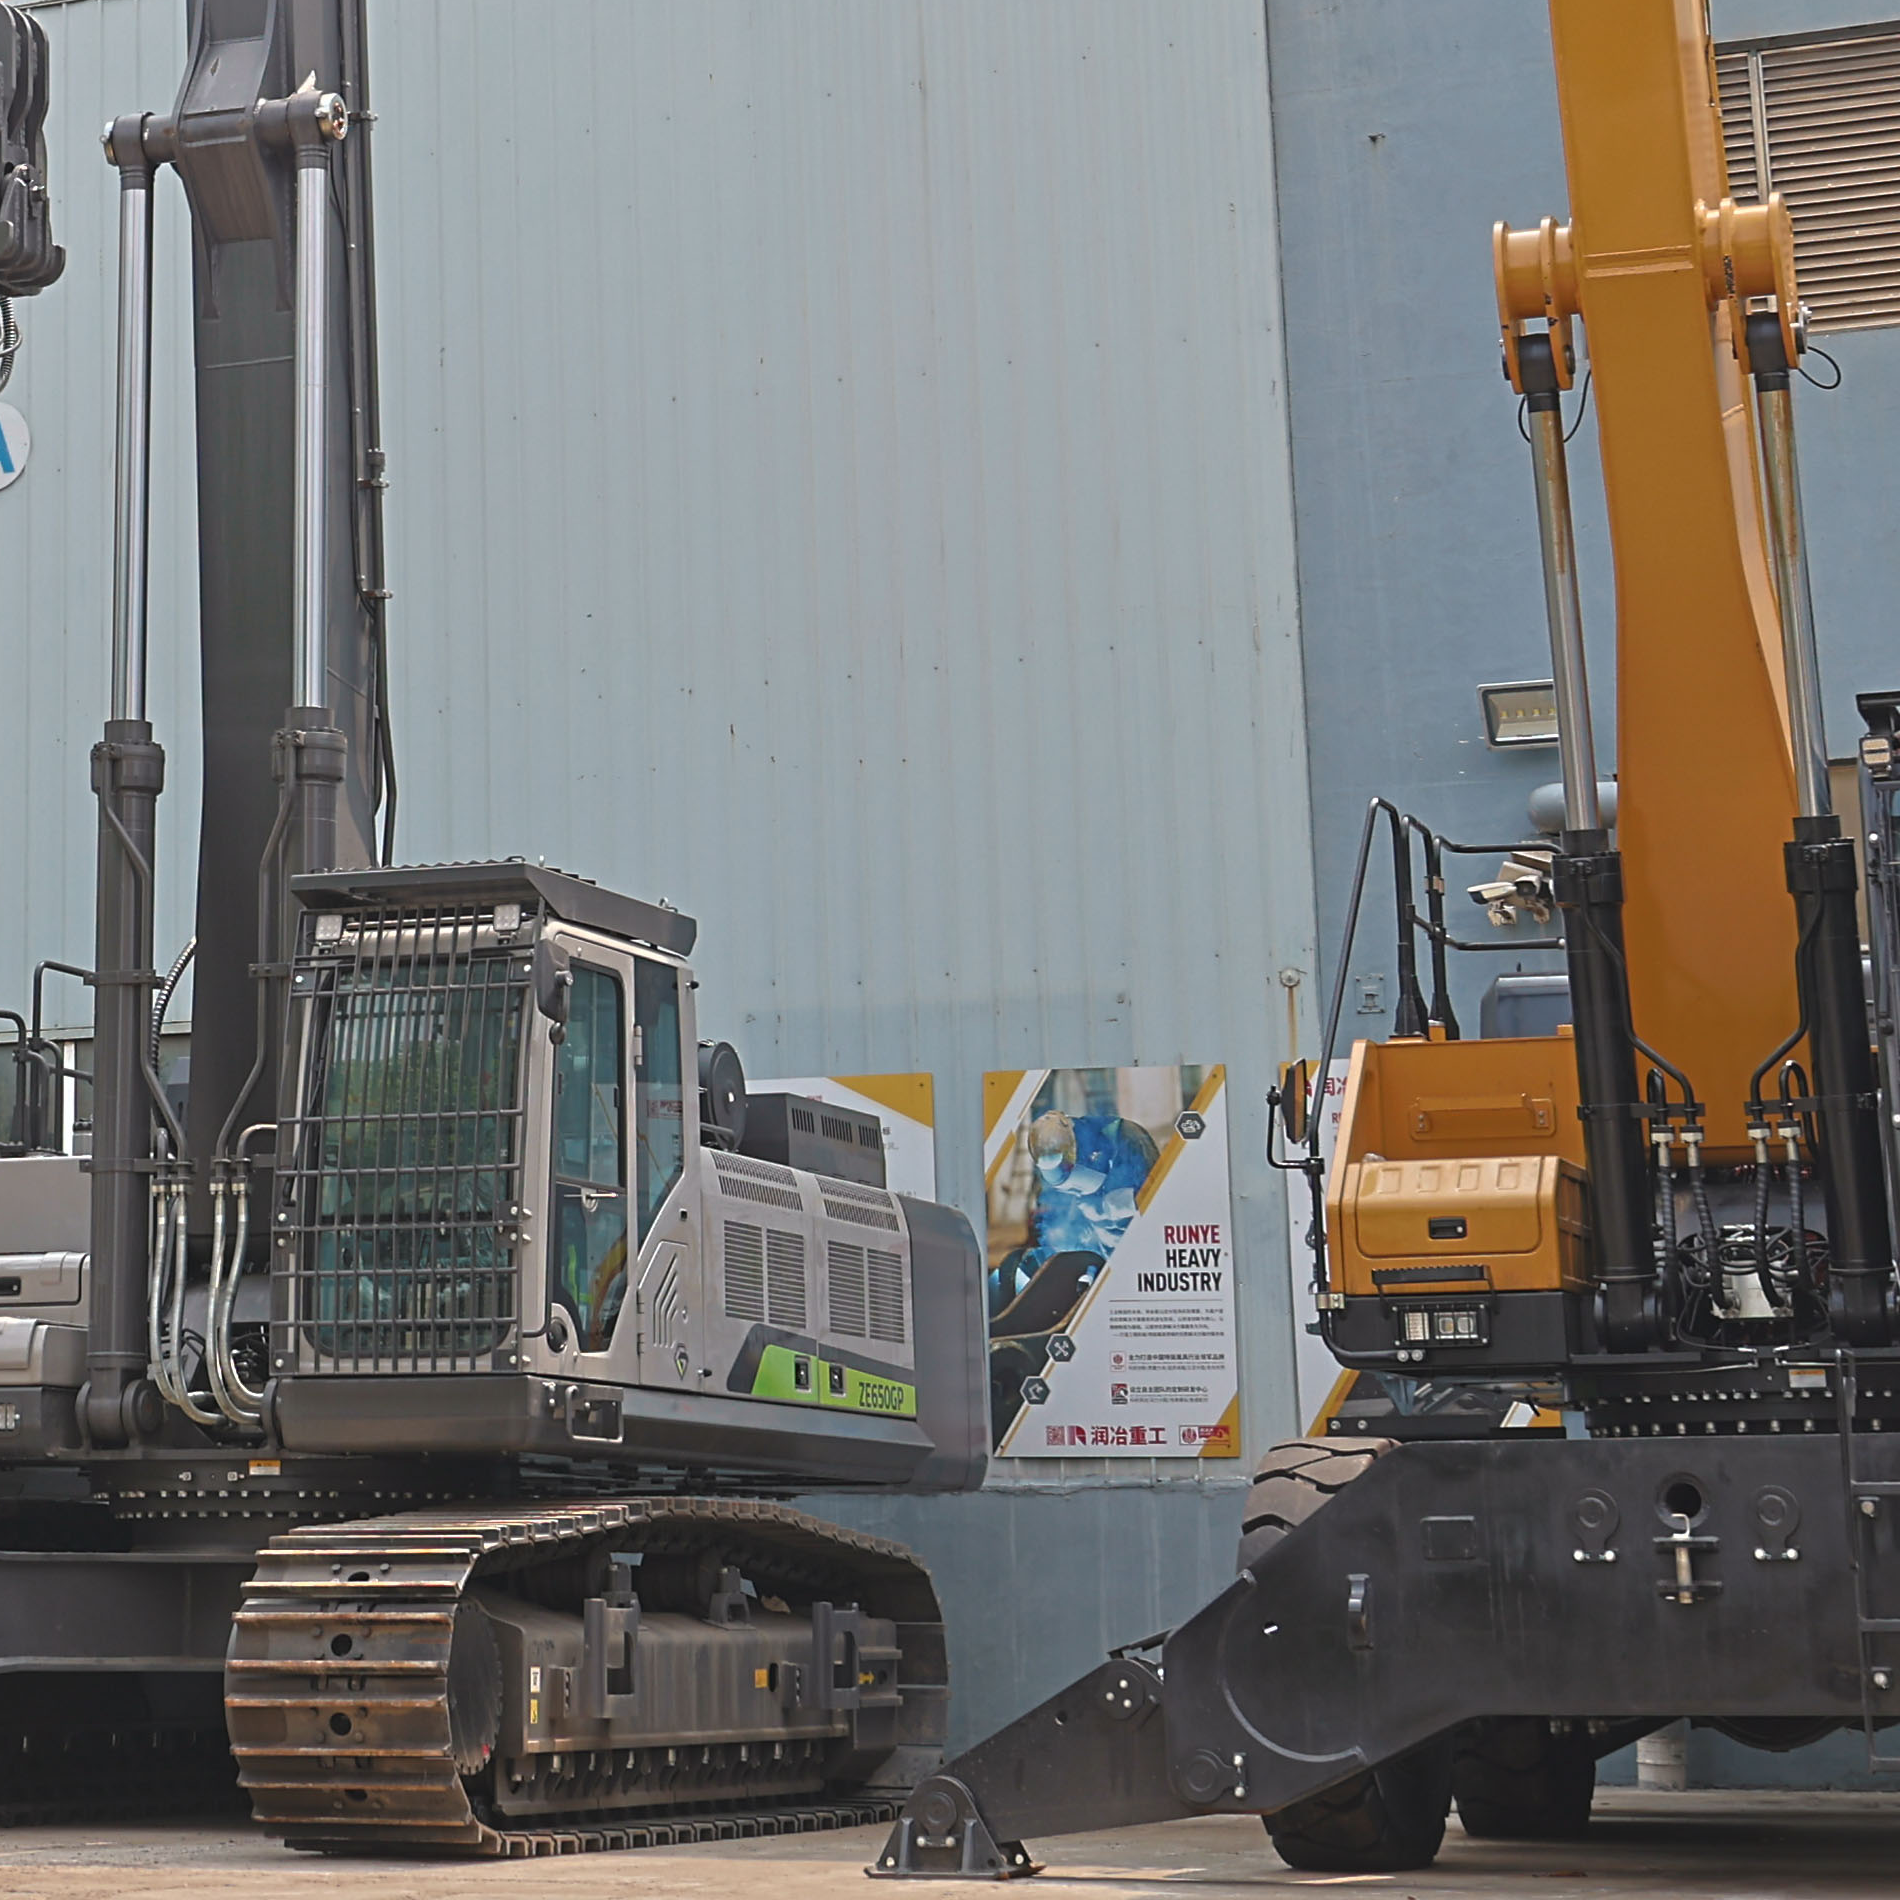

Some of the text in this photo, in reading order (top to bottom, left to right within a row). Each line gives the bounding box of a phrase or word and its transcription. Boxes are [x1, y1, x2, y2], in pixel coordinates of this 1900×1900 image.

[1164, 1224, 1220, 1244] RUNYE
[1166, 1248, 1221, 1268] HEAVY
[1137, 1272, 1222, 1292] INDUSTRY
[858, 1382, 905, 1410] ZE650GP
[1091, 1425, 1168, 1446] 润冶重工
